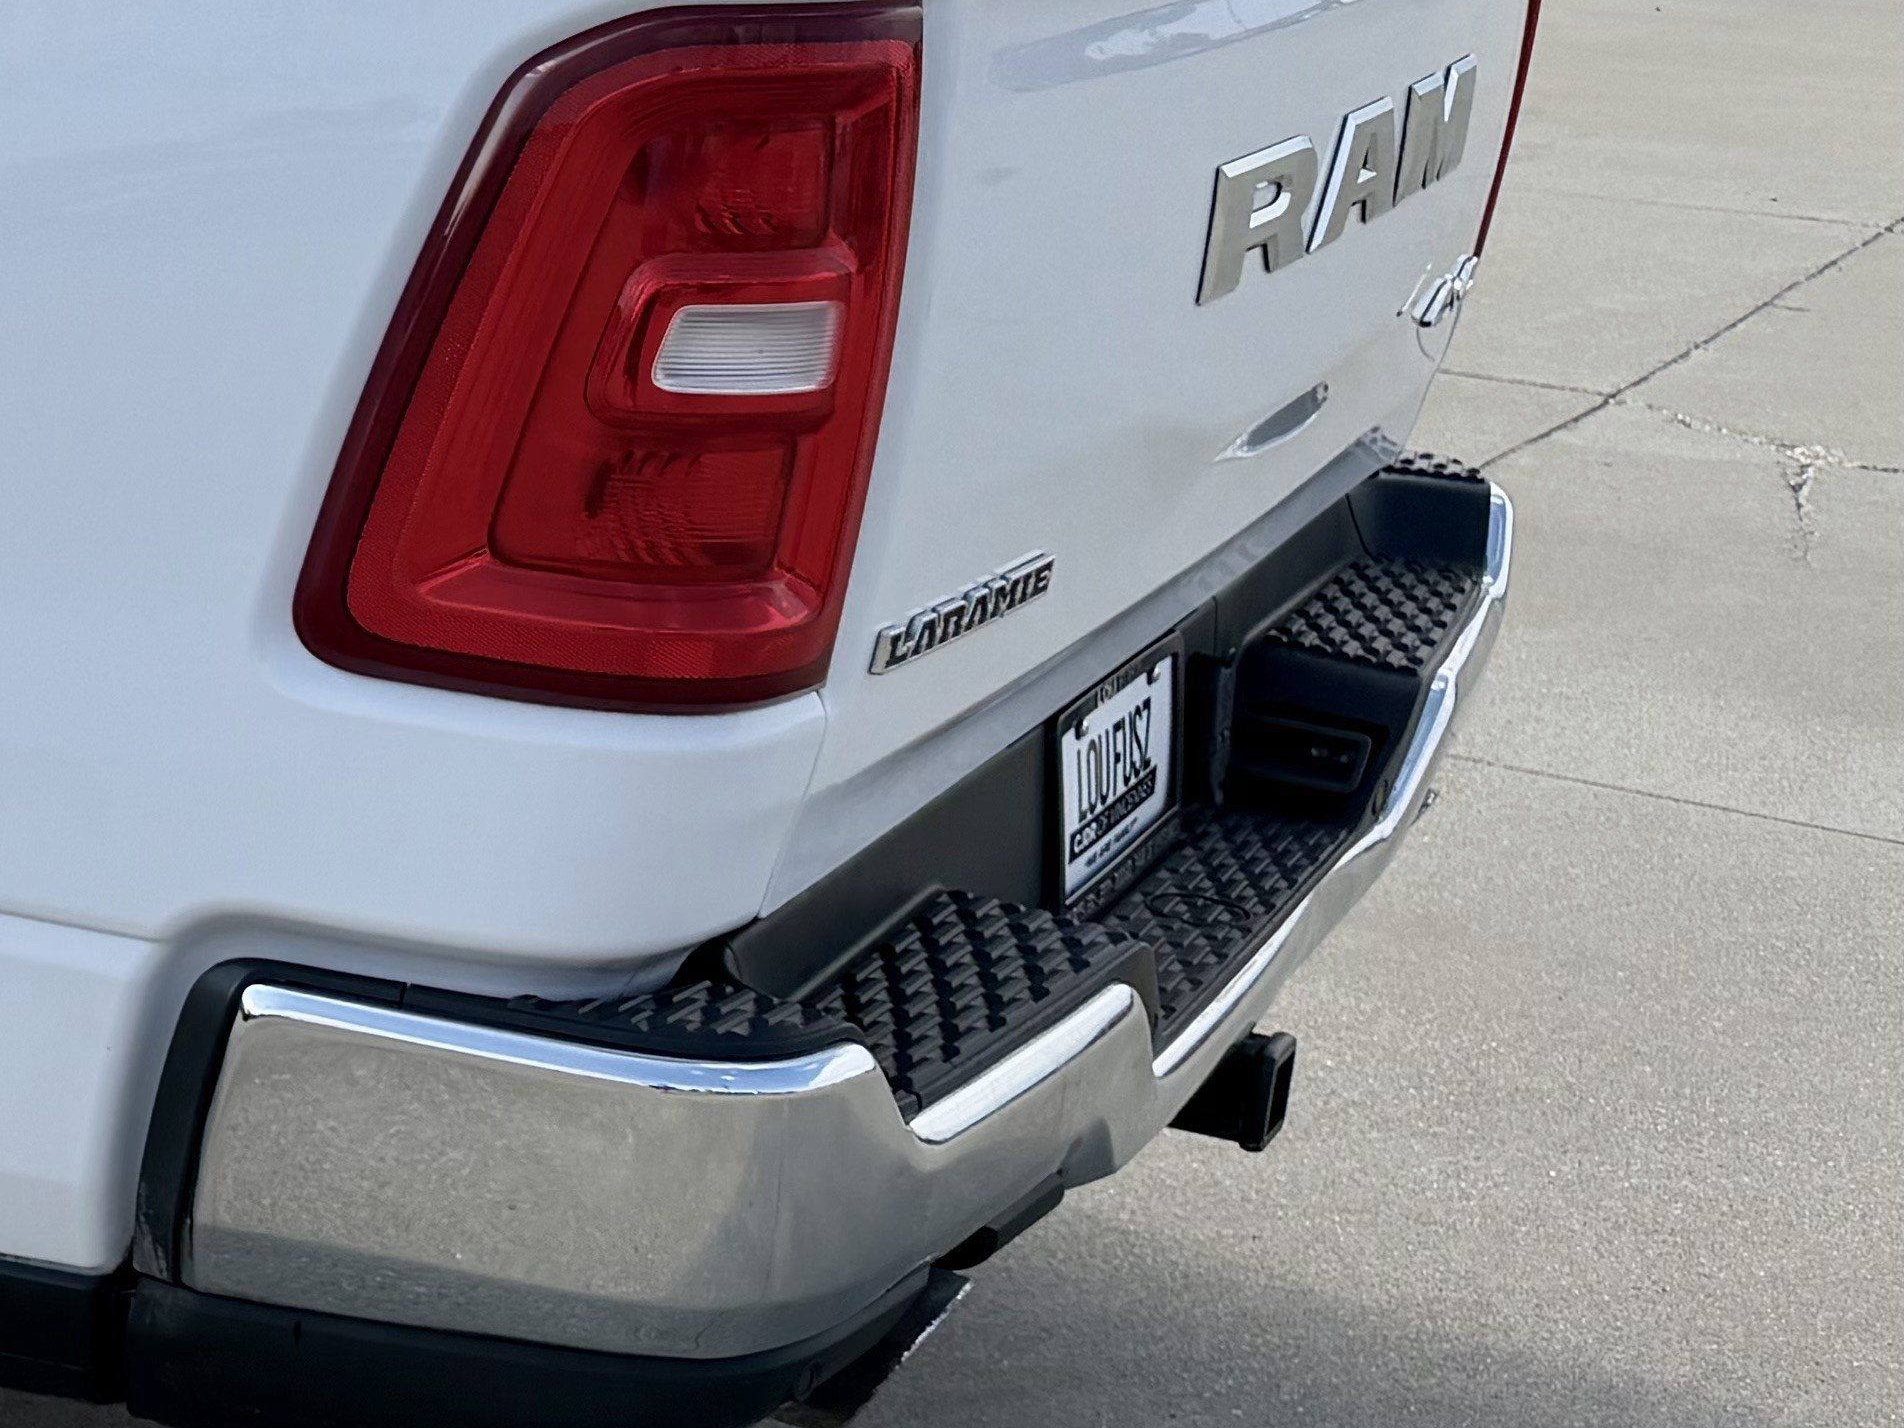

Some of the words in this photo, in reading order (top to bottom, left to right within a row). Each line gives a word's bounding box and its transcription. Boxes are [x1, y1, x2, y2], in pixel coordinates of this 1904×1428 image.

[1195, 52, 1478, 306] RAM
[868, 549, 1056, 675] LARAMIE
[1076, 727, 1111, 824] LOU
[1112, 696, 1152, 797] FUSZ
